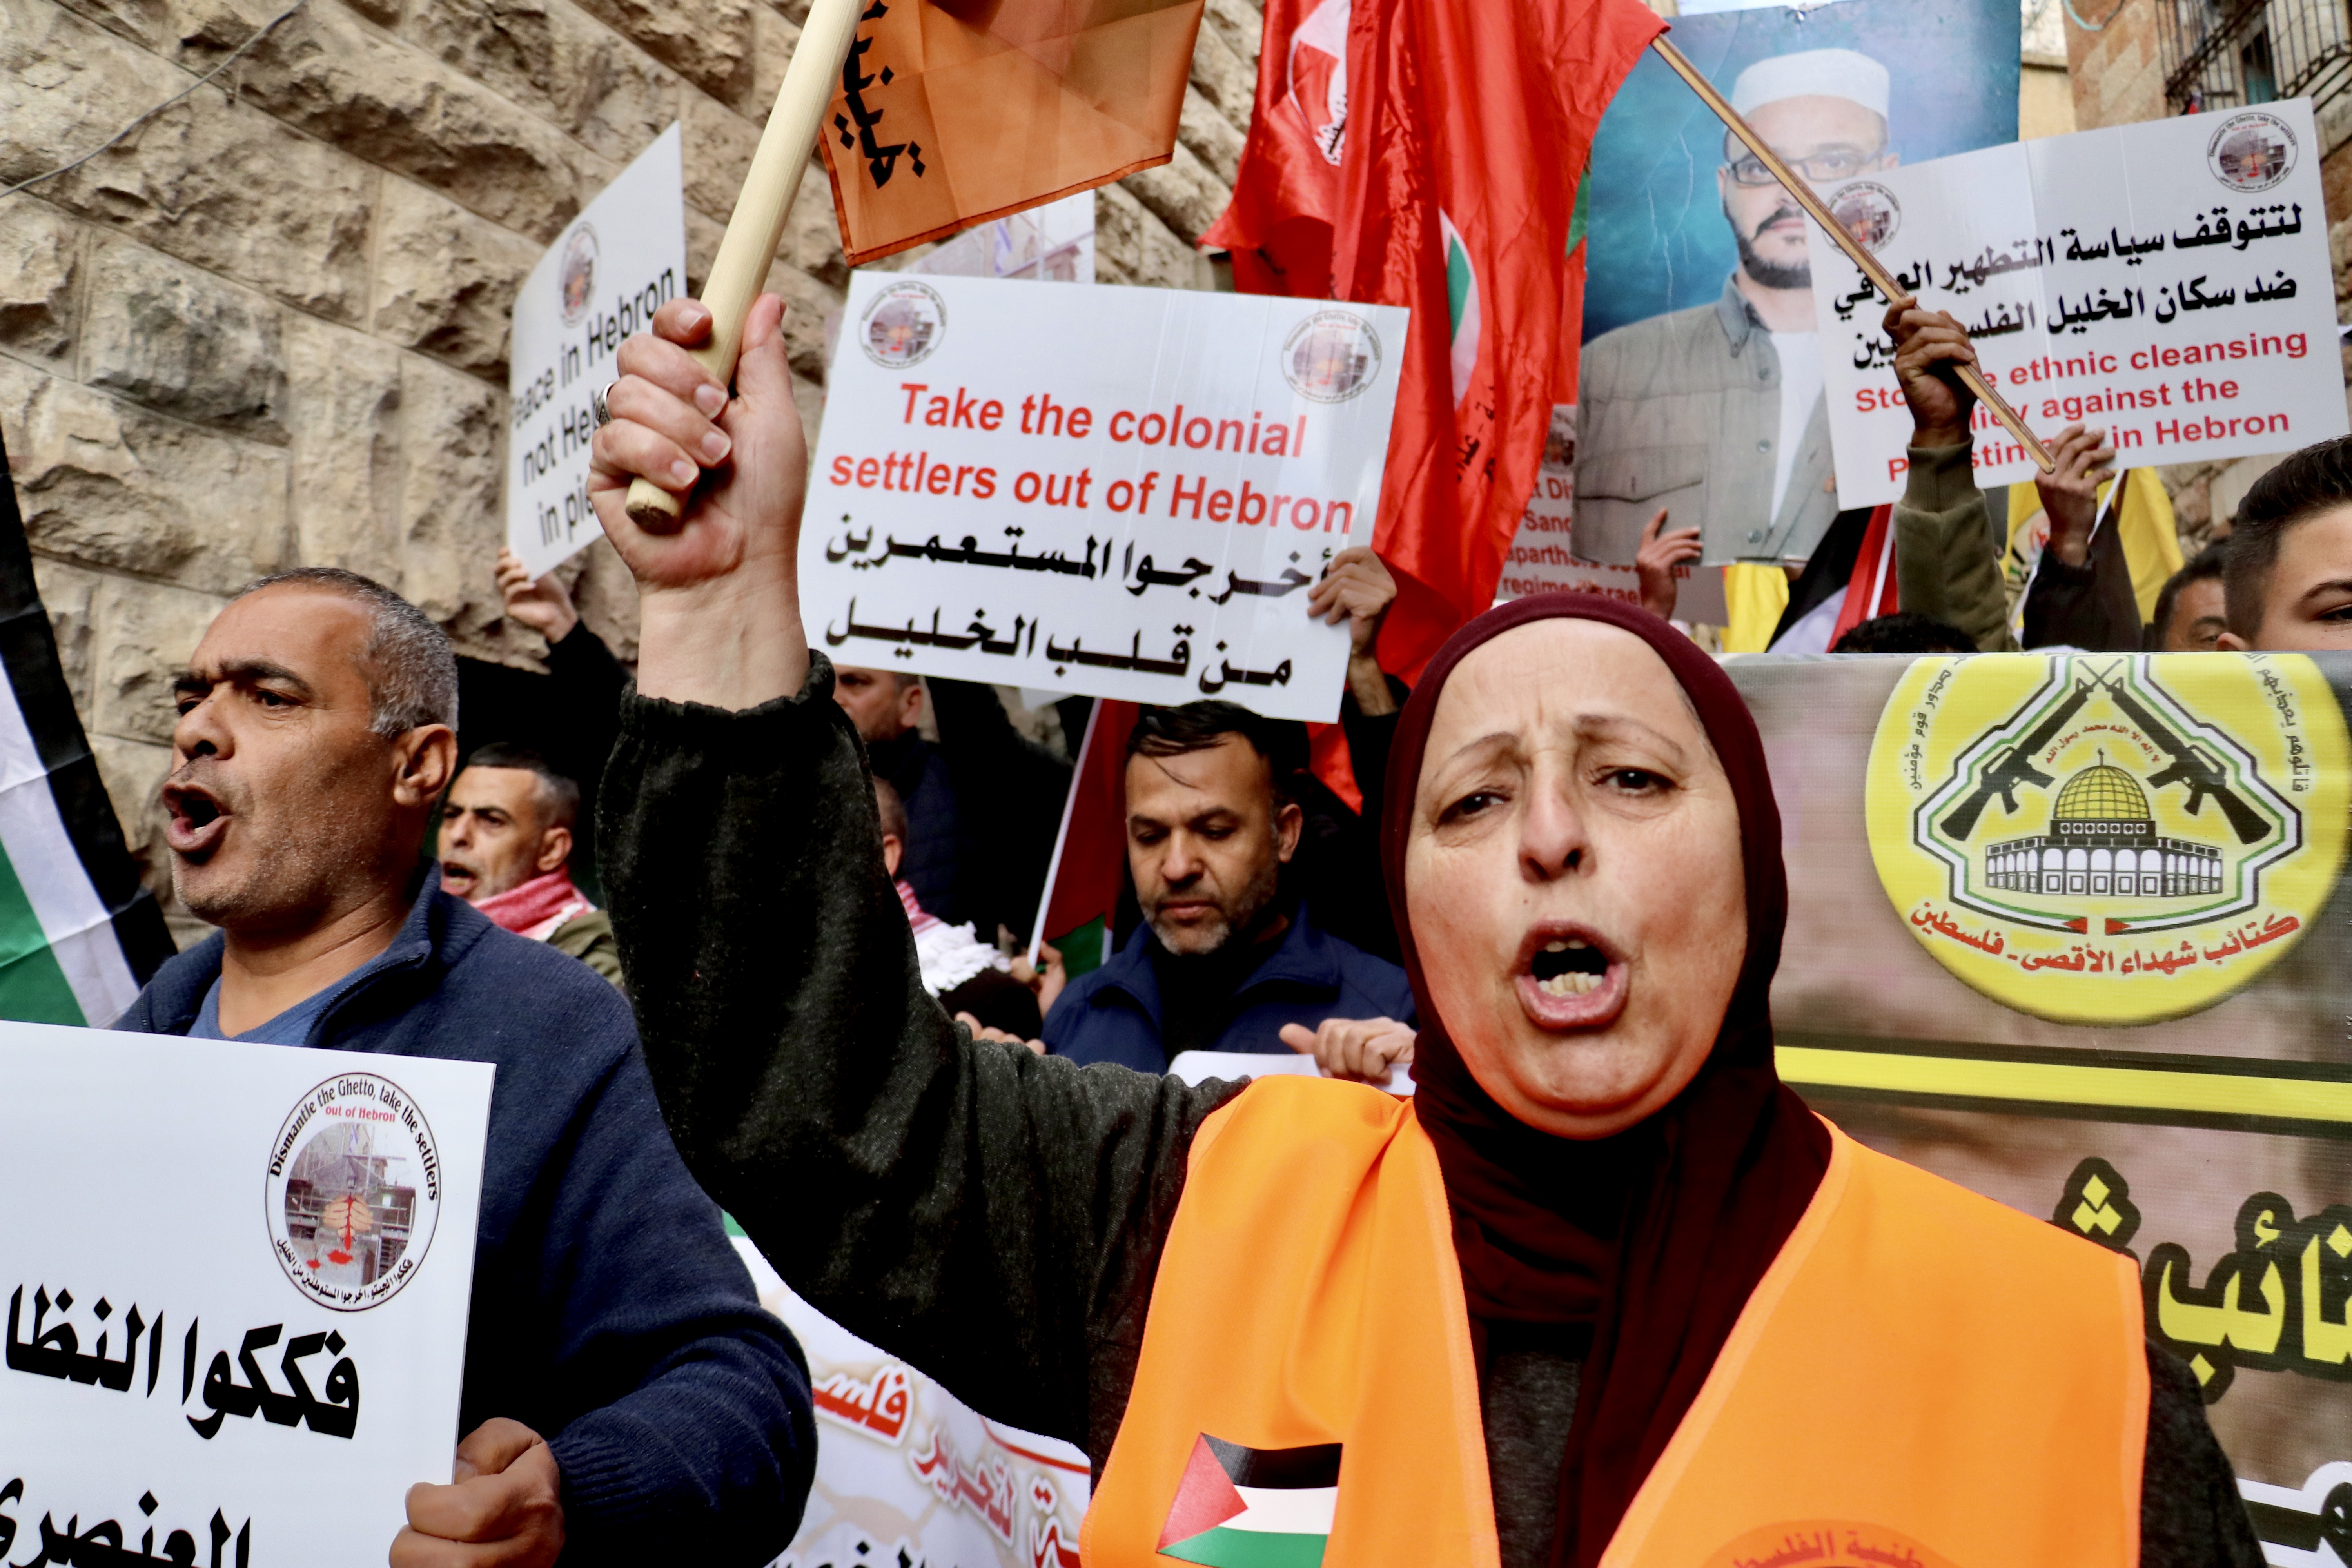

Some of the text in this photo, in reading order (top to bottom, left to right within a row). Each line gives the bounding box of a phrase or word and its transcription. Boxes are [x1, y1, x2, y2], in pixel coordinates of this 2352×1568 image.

[2061, 227, 2165, 266] سياسة
[2172, 202, 2302, 251] لتتوقف
[1940, 236, 2054, 294] التطهير
[2244, 270, 2297, 303] ضد
[2047, 287, 2145, 334] الخليل
[2155, 275, 2235, 324] سكان
[561, 343, 579, 388] in
[588, 267, 674, 367] Hebron
[1855, 387, 1908, 412] Sto
[2009, 351, 2118, 385] ethnic
[2130, 332, 2308, 370] cleansing
[900, 382, 1307, 457] Take the colonial
[2042, 382, 2172, 421] against
[2181, 378, 2239, 404] the
[524, 425, 556, 487] not
[2112, 412, 2290, 449] in Hebron
[829, 451, 1353, 534] settlers out of Hebron
[538, 501, 560, 546] in
[825, 513, 1112, 580] المستعمرين
[825, 595, 1292, 695] من قلب الخليل
[1911, 902, 2004, 955] فلسطين
[2203, 913, 2300, 965] كتائب
[2120, 940, 2198, 975] شهداء
[269, 1078, 438, 1201] Dismantle the Ghetto, take the settlers
[325, 1105, 396, 1122] out of Hebron
[5, 1283, 360, 1440] فككوا النظا
